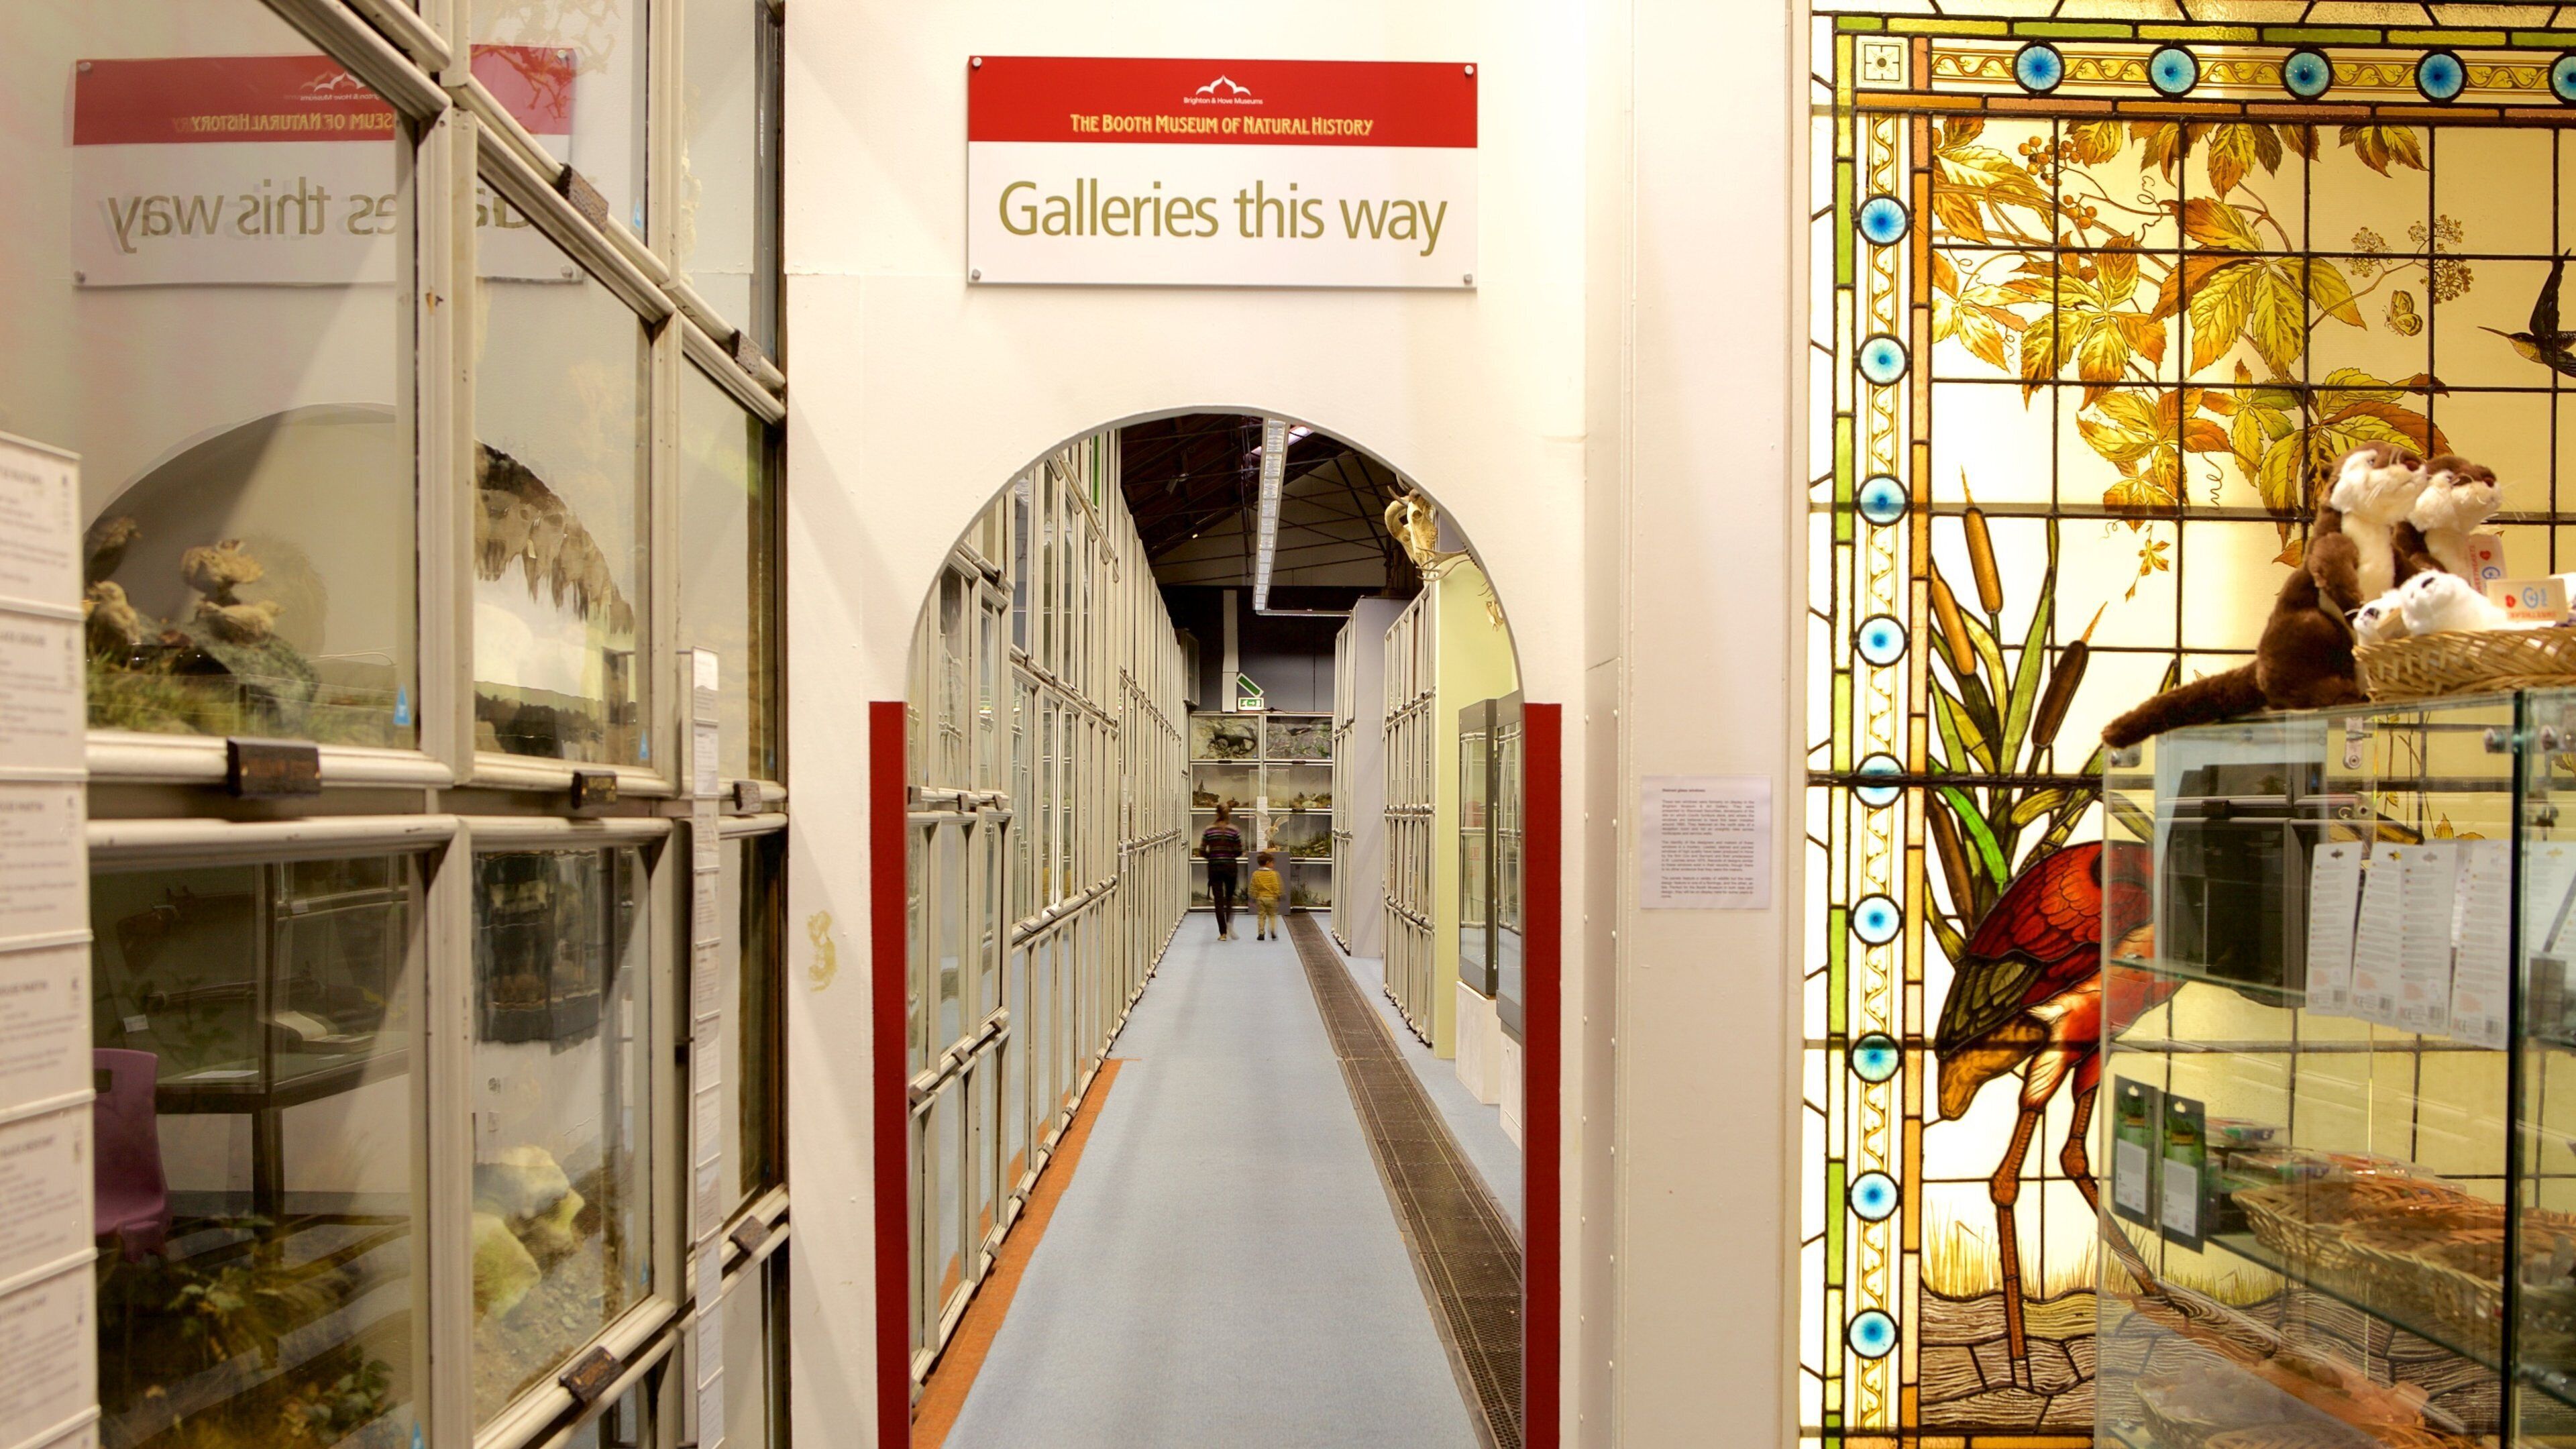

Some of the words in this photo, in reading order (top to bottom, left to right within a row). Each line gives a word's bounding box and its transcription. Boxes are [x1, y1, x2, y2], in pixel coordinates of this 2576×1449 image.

[1183, 97, 1210, 105] Brighton
[1070, 113, 1099, 133] THE
[1102, 114, 1153, 133] BOOTH
[1155, 115, 1218, 133] MUSEUM
[1243, 116, 1310, 134] NATURAL
[1311, 117, 1373, 136] HISTORY
[999, 178, 1219, 237] Galleries
[1234, 180, 1325, 239] this
[1339, 198, 1448, 258] way
